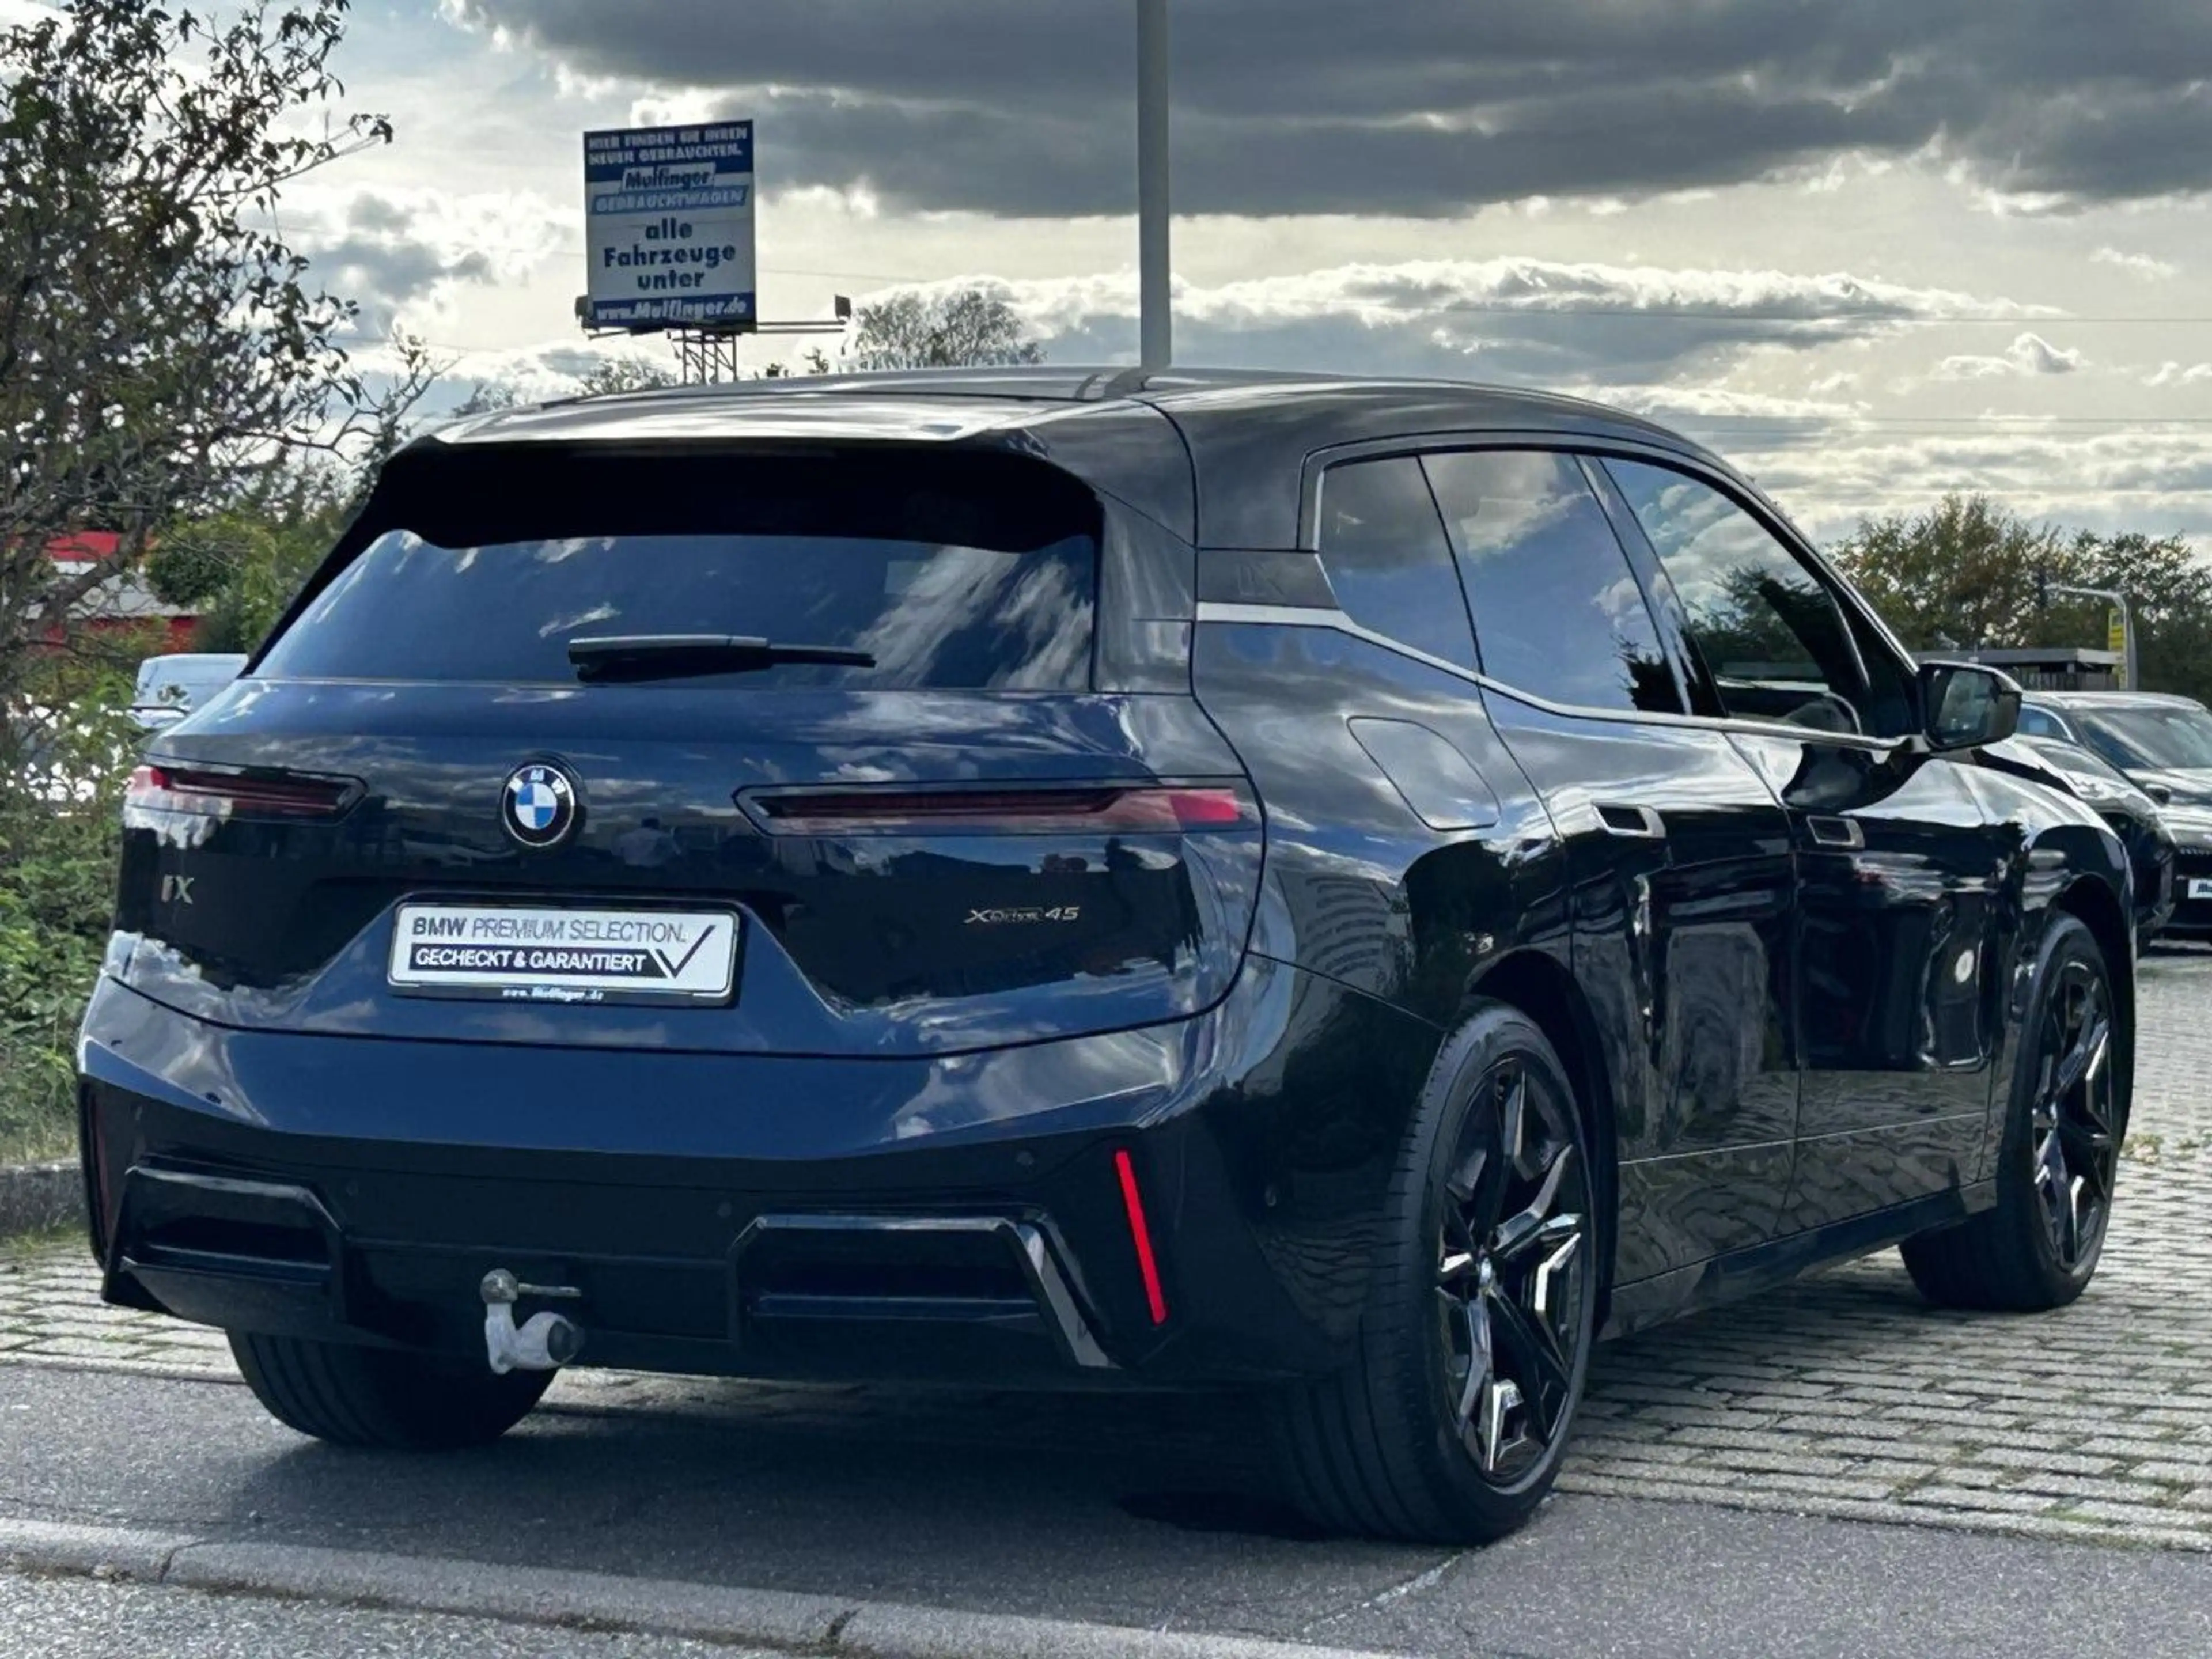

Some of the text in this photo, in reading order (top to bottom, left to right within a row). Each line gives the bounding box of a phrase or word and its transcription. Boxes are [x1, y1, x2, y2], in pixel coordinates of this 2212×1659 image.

[624, 131, 675, 147] FINDEN
[596, 189, 744, 212] GEBRAUCHTWAGEN
[646, 217, 692, 240] alle
[604, 244, 736, 268] Fahrzeuge
[638, 270, 705, 290] unter
[412, 916, 467, 937] BMW
[472, 918, 565, 940] PREMIUM
[415, 948, 647, 972] GECHECKT & GARANTIERT
